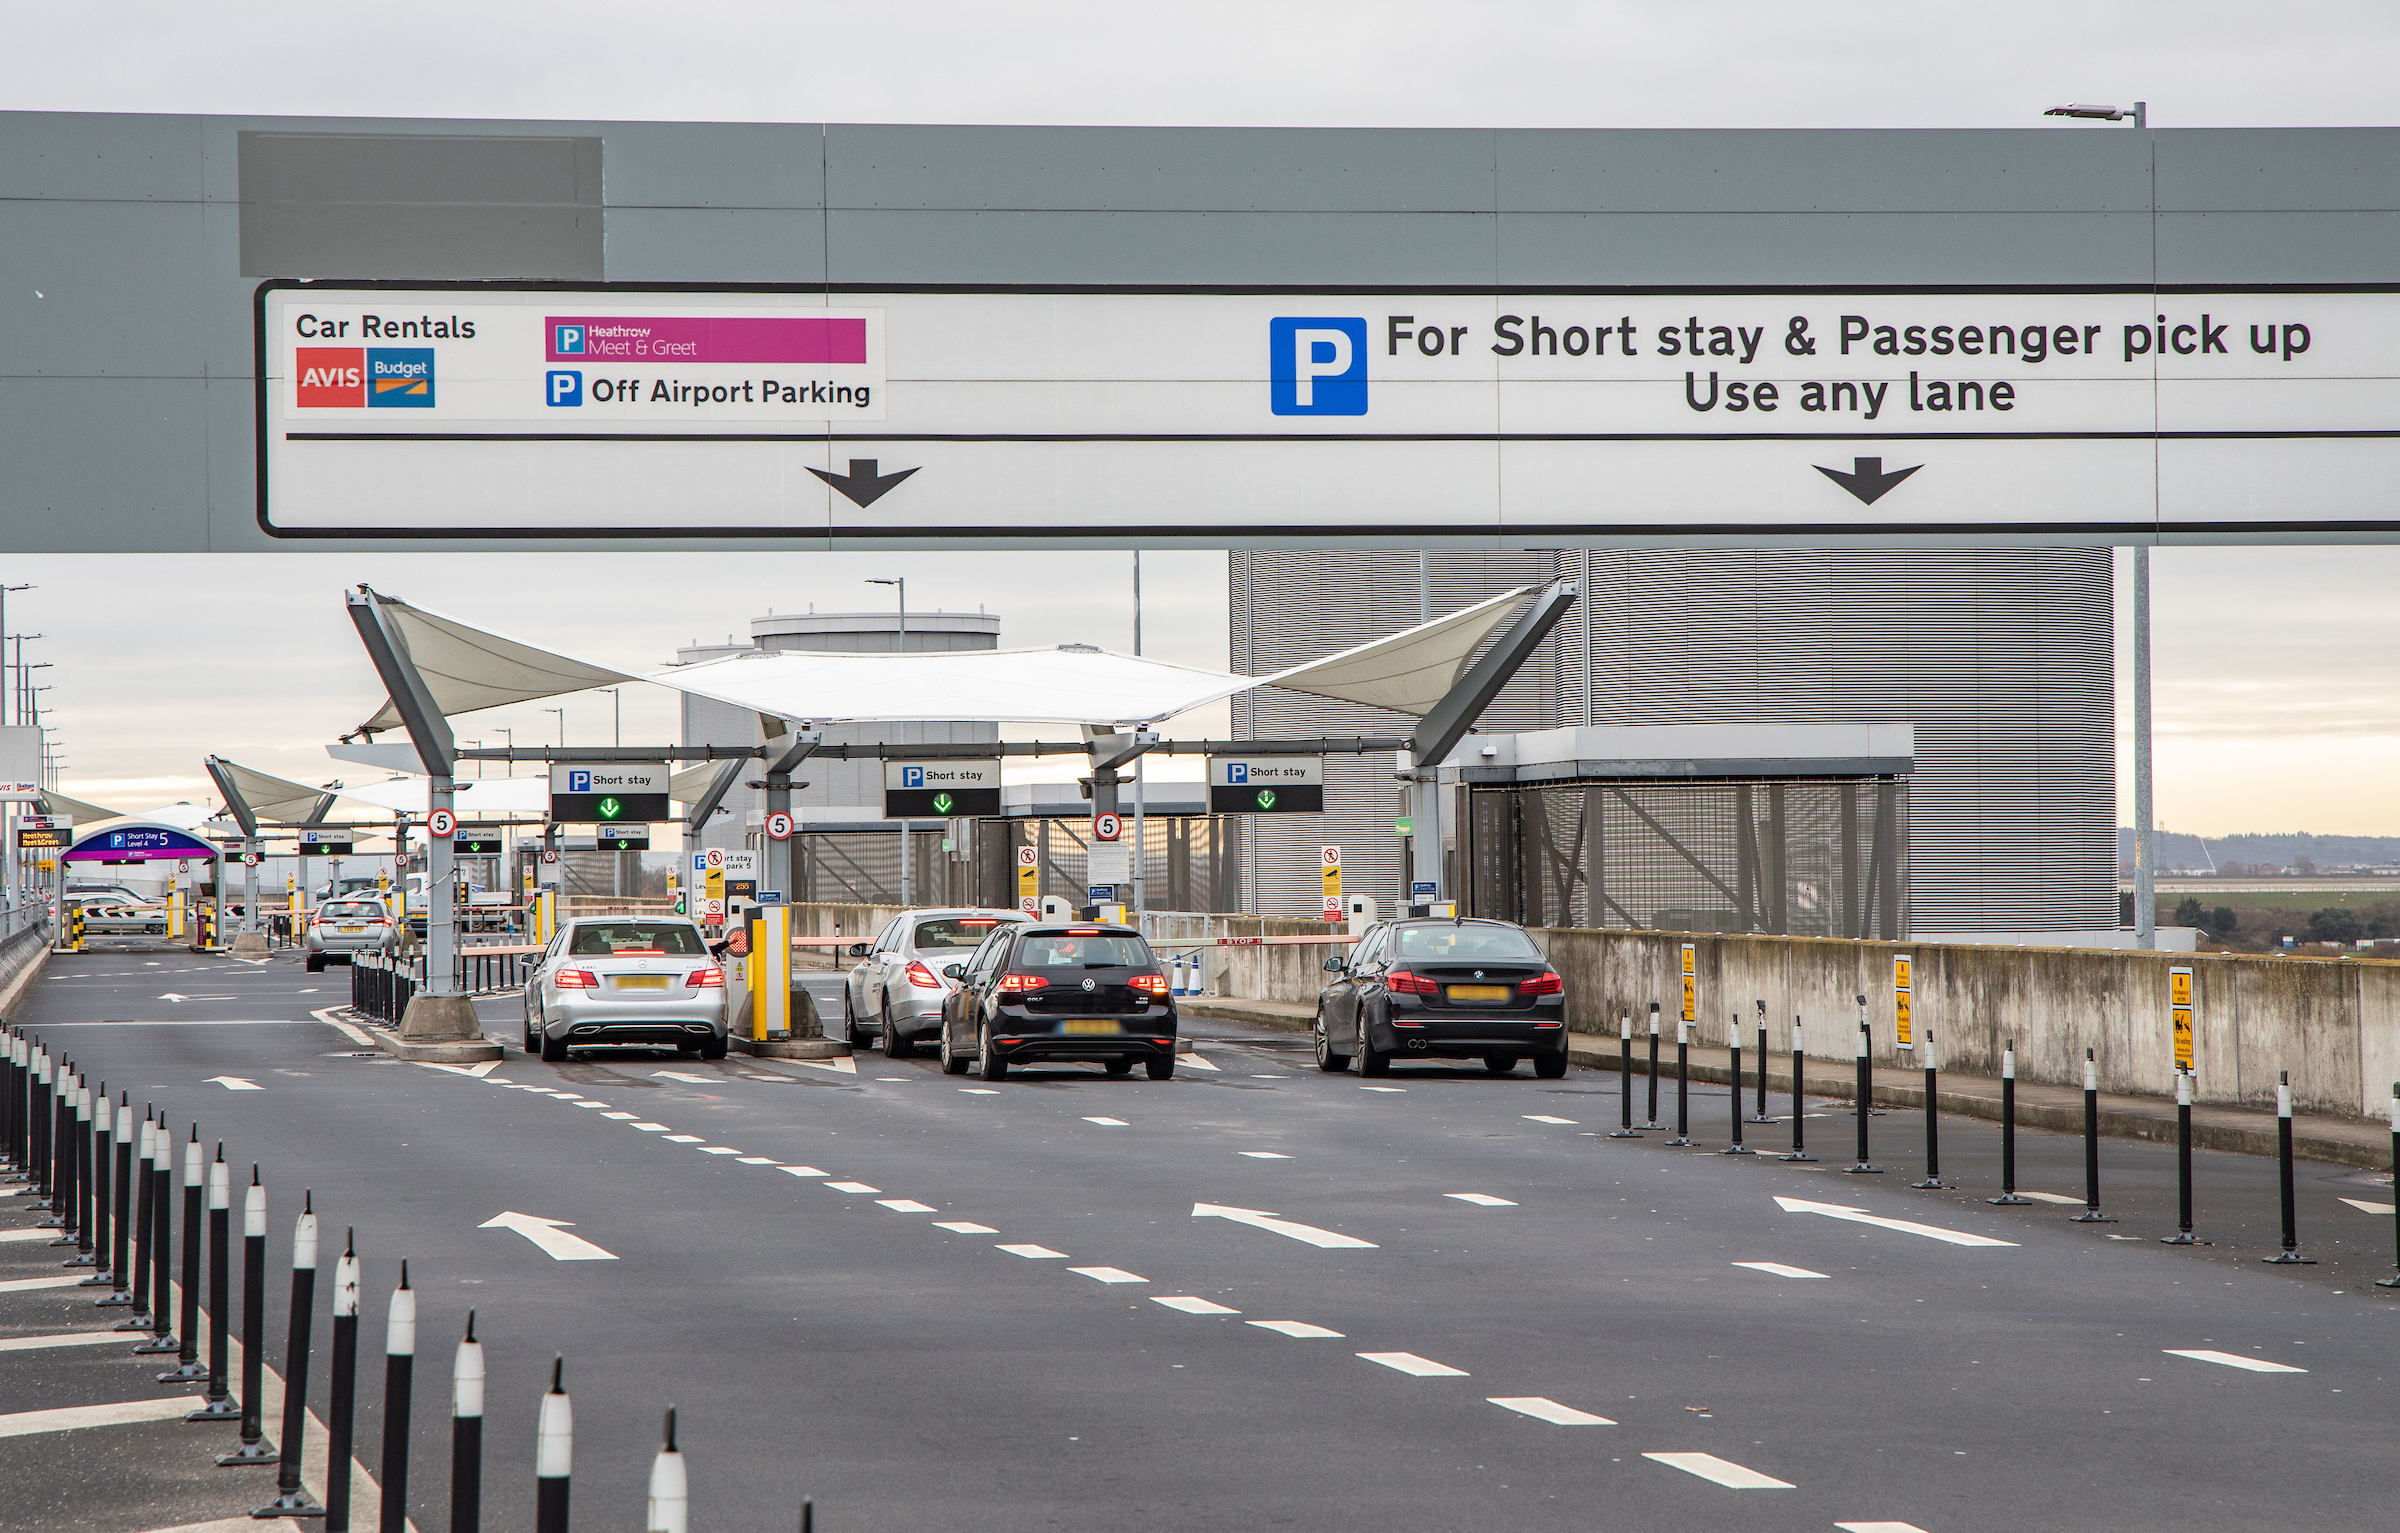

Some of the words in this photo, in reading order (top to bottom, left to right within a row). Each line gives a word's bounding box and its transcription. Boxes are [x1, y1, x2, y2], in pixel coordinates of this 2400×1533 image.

[296, 314, 349, 338] Car
[362, 314, 475, 338] Rentals
[589, 325, 651, 338] Heathrow
[564, 328, 580, 352] P
[1388, 315, 1467, 357] For
[1491, 314, 1637, 357] Short
[1657, 316, 1763, 363] stay
[1785, 315, 1816, 356] &
[1840, 315, 2101, 363] Passenger
[2123, 314, 2229, 363] pick
[2250, 323, 2311, 362] up
[589, 340, 631, 355] Meet
[635, 340, 649, 356] &
[652, 340, 697, 356] Greet
[375, 361, 427, 378] Budget
[1294, 327, 1353, 407] P
[301, 367, 360, 388] AVIS
[552, 374, 575, 402] P
[592, 378, 640, 402] Off
[651, 380, 754, 407] Airport
[762, 380, 870, 408] Parking
[1685, 371, 1779, 412] Use
[1800, 381, 1889, 420] any
[1909, 371, 2015, 412] lane
[593, 775, 623, 785] Short
[627, 775, 651, 786] stay
[926, 771, 955, 780] Short
[960, 771, 983, 781] stay
[1250, 767, 1279, 777] Short
[1283, 767, 1306, 778] stay
[437, 815, 448, 830] 5
[774, 818, 785, 833] 5
[1103, 818, 1113, 834] 5
[127, 832, 144, 840] Short
[145, 832, 159, 840] Stay
[160, 832, 168, 846] 5
